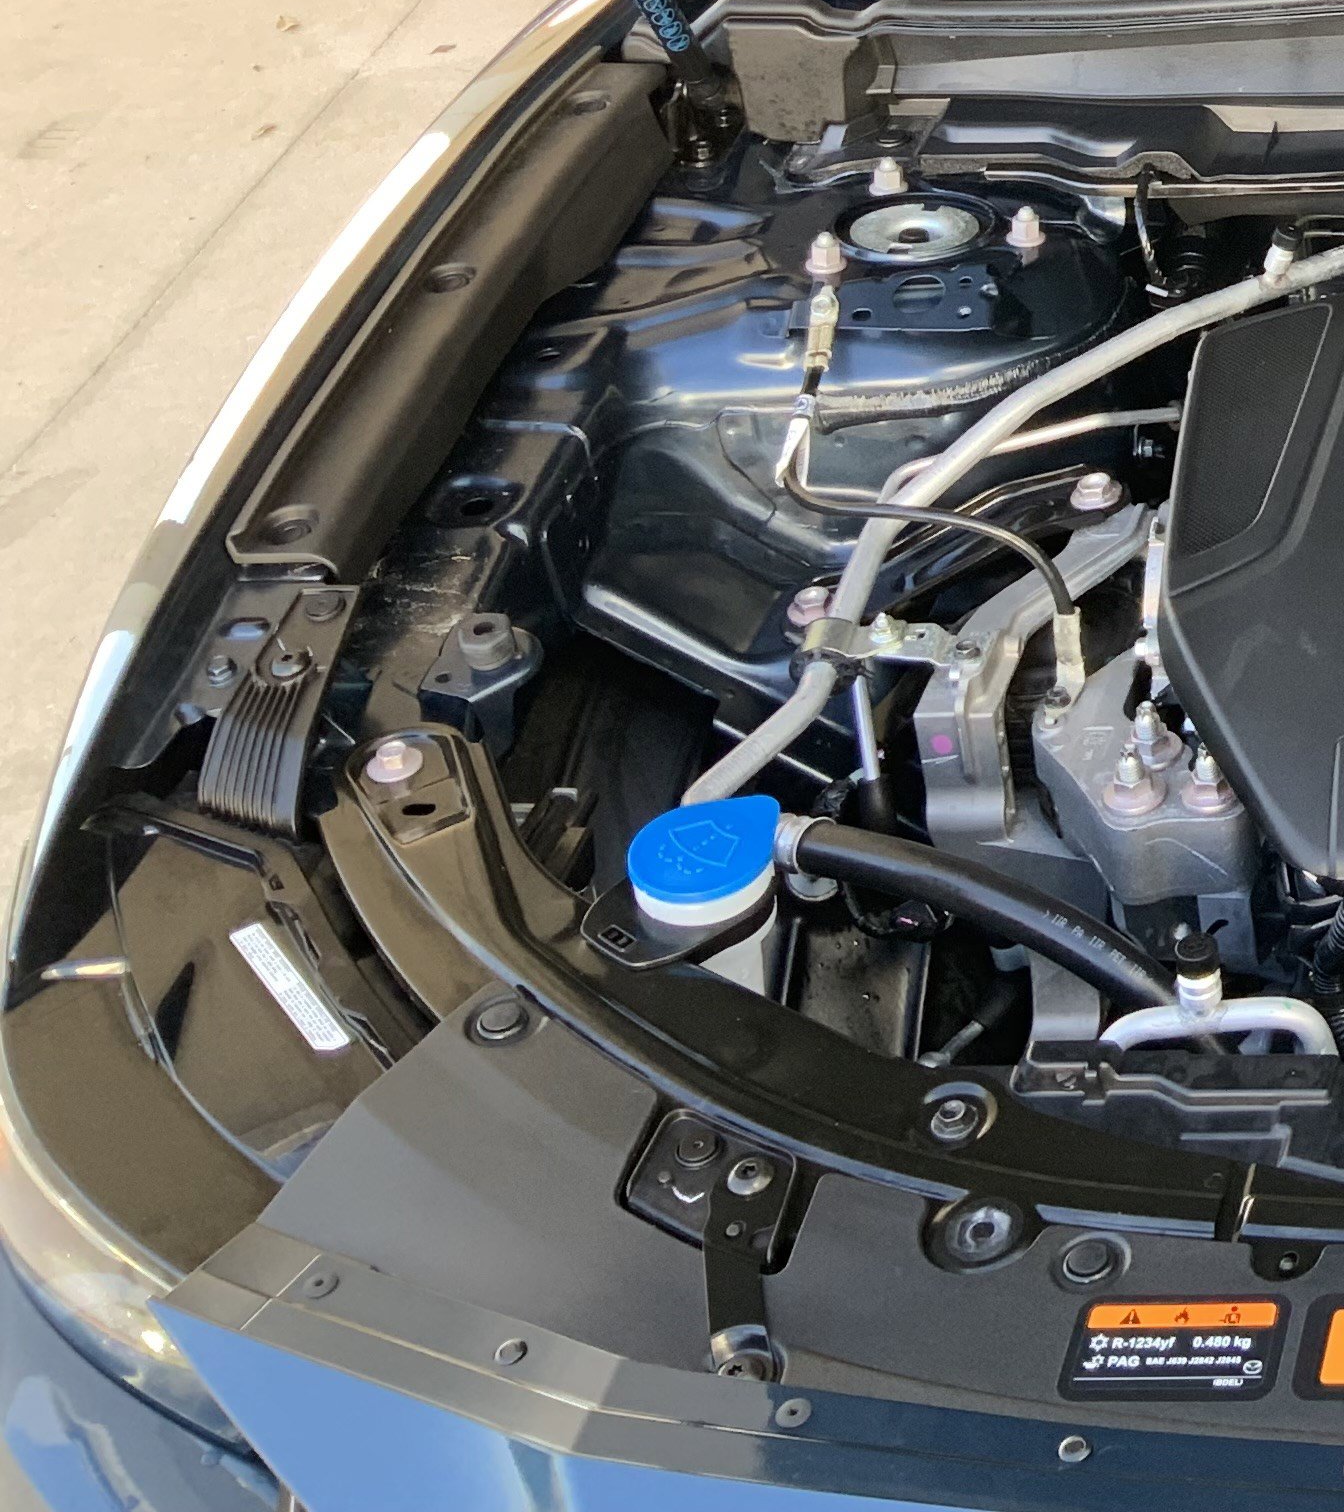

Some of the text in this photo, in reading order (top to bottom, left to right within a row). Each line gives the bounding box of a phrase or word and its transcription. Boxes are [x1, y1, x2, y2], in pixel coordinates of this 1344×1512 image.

[1111, 1335, 1251, 1352] R-1234yf 0.480 kg
[1107, 1355, 1140, 1368] PAG
